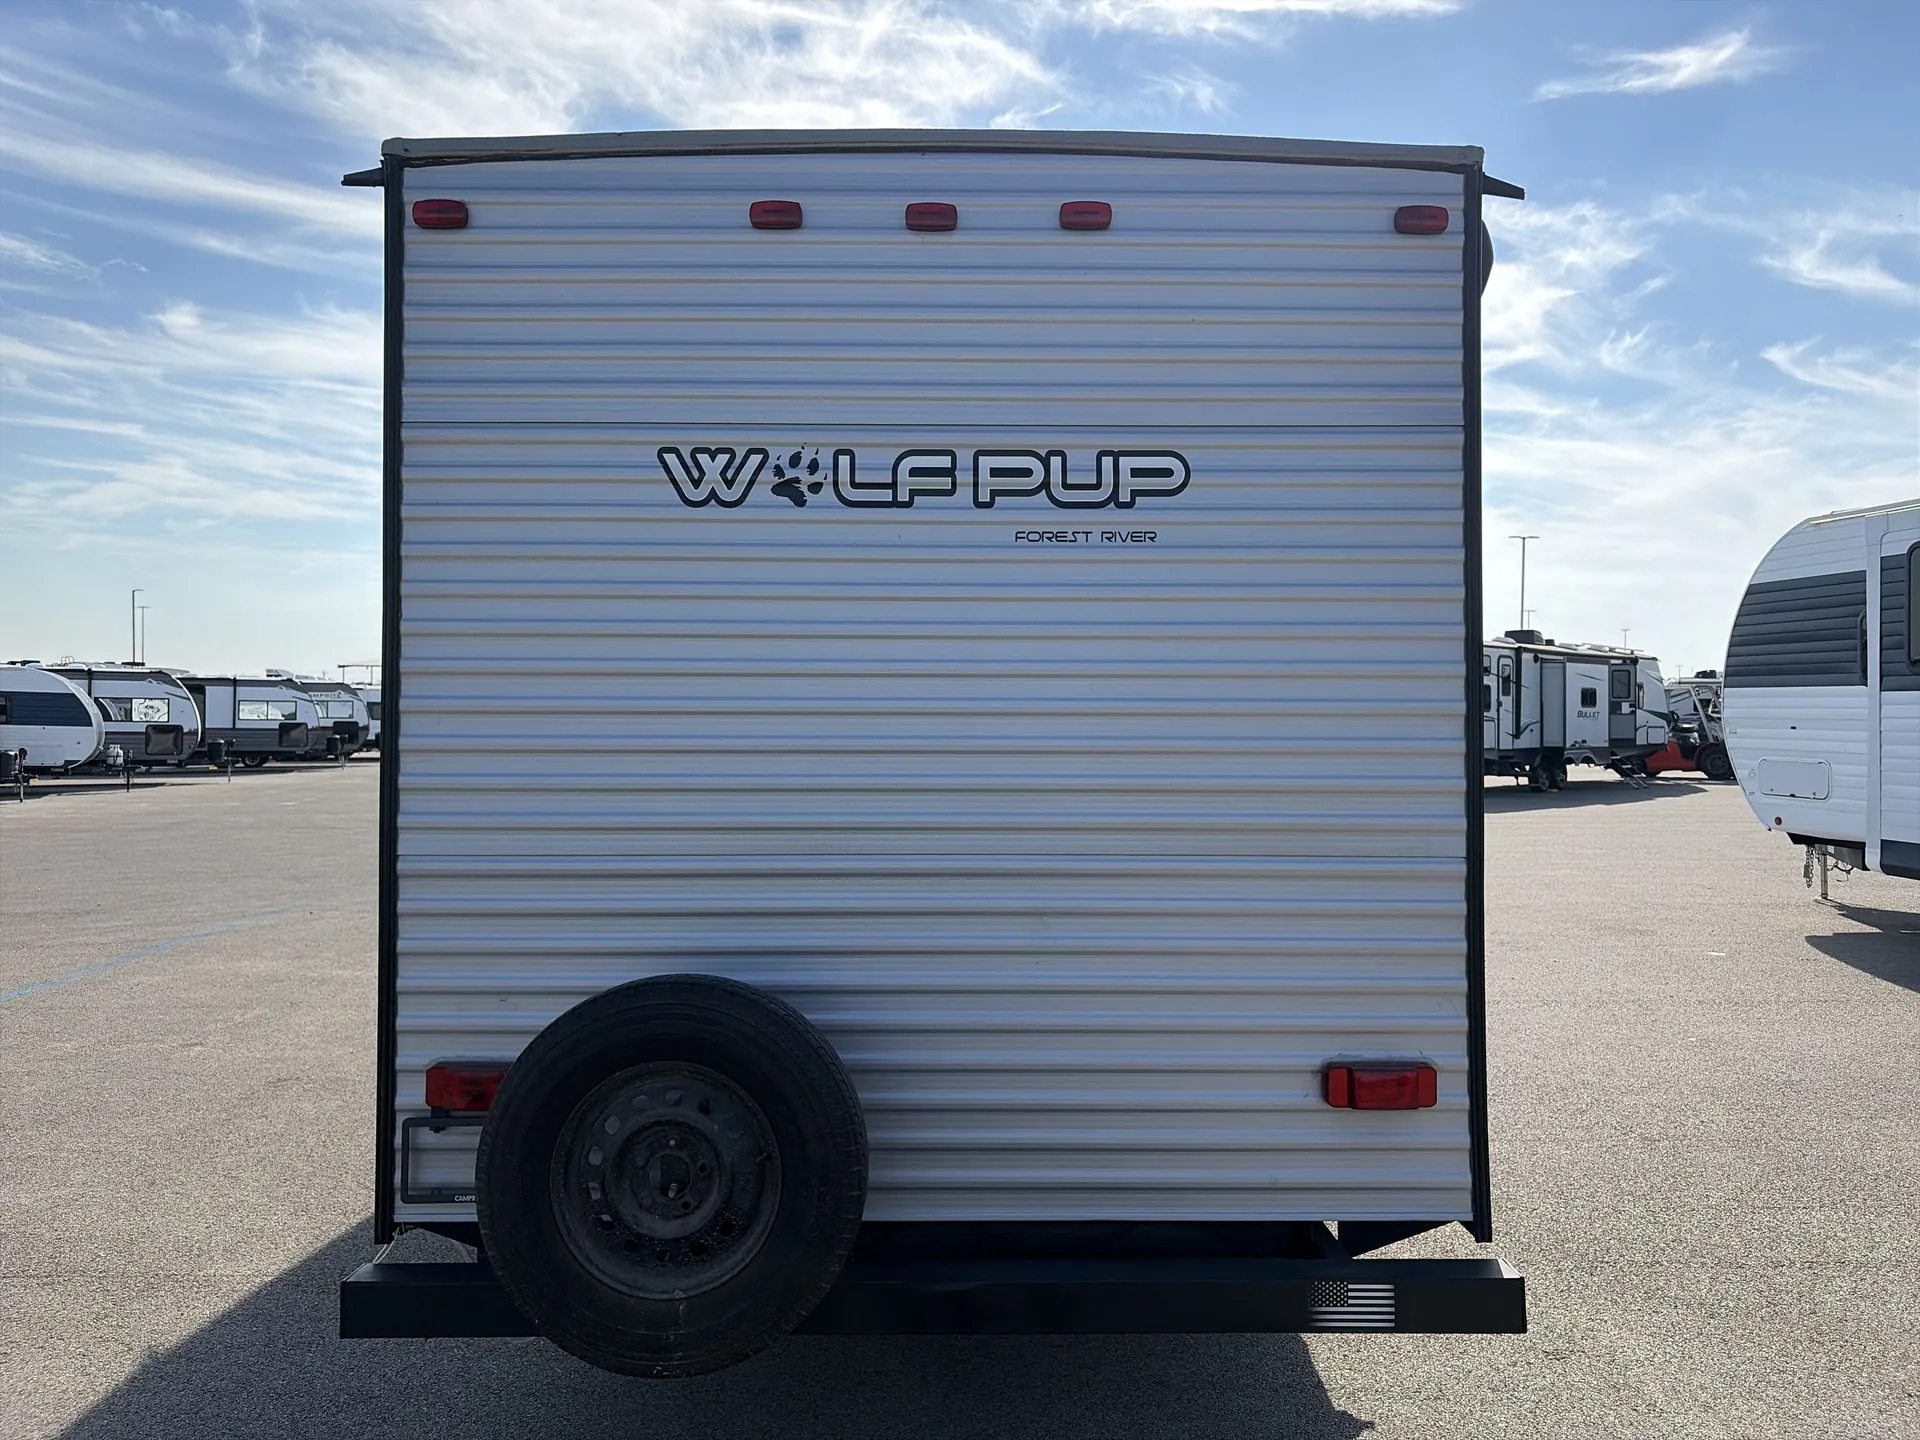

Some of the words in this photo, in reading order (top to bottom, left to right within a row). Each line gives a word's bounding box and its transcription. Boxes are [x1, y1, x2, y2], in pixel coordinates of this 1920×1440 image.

[972, 449, 1192, 510] PUP
[1014, 530, 1093, 543] FOREST
[1100, 530, 1158, 543] RIVER
[1577, 710, 1600, 718] BULLET
